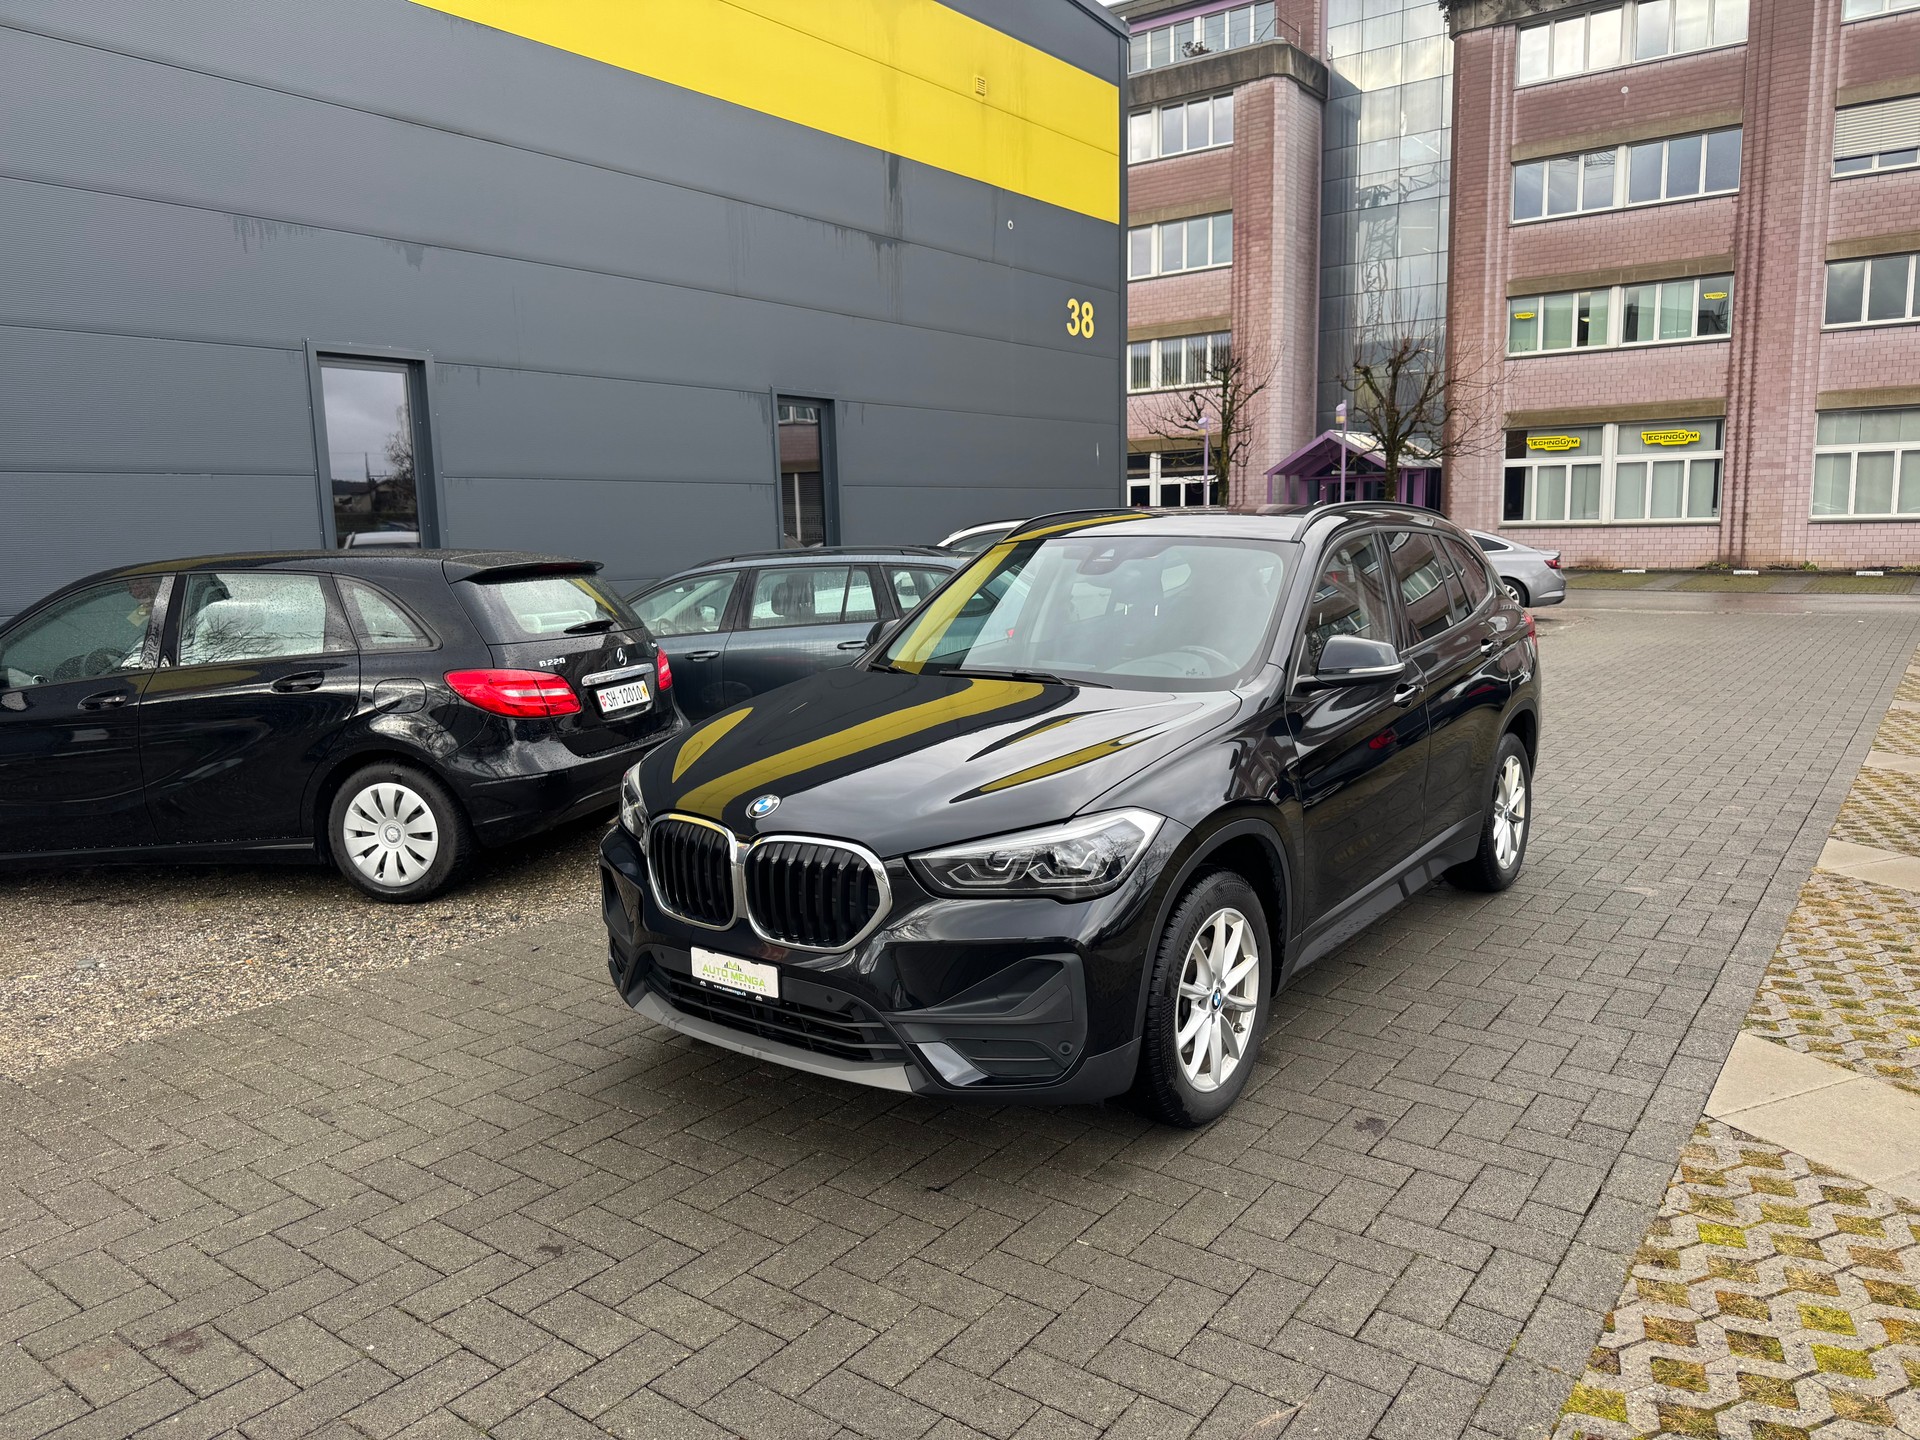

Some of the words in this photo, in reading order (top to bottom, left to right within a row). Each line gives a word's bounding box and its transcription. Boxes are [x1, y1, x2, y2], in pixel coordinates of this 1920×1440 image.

[1066, 297, 1095, 339] 38
[702, 964, 729, 979] AUTO
[730, 970, 767, 988] MENGA
